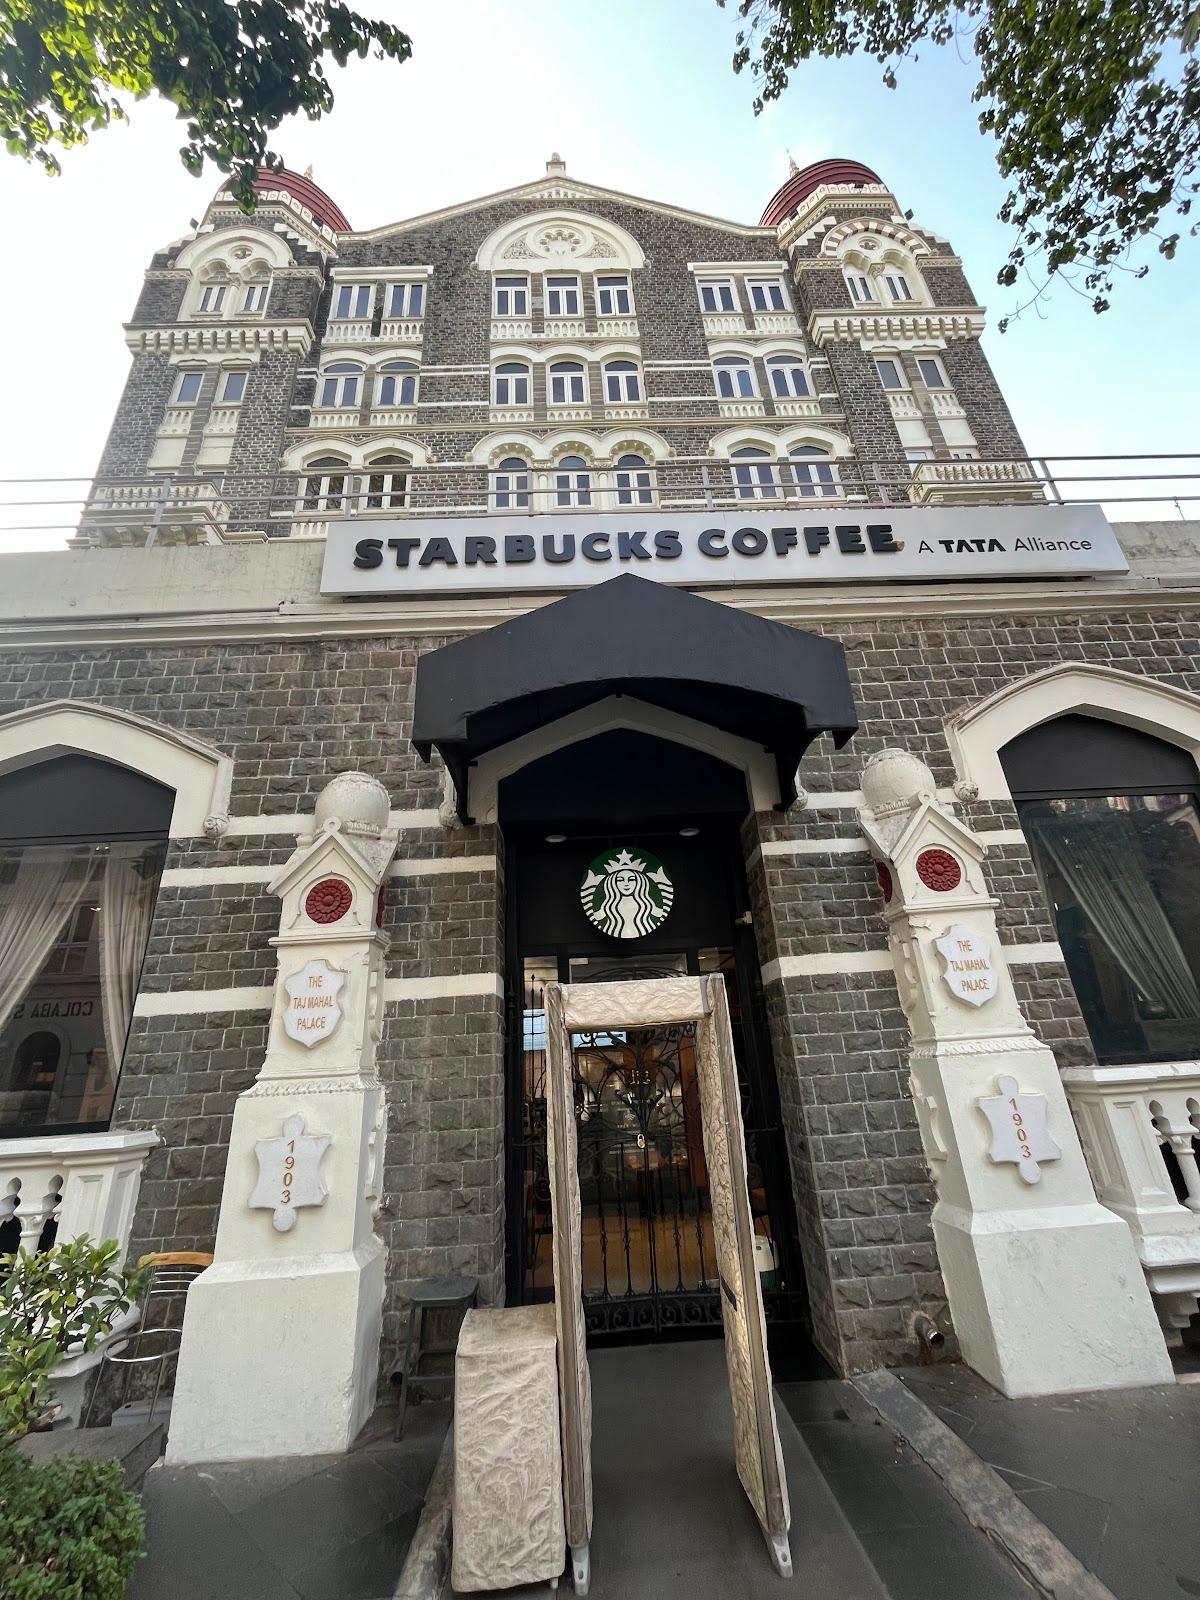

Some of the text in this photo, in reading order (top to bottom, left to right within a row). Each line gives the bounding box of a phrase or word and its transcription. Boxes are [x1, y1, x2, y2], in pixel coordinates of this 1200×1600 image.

[353, 523, 899, 570] STARBUCKS COFFEE
[918, 537, 1093, 554] A TATA Alliance
[957, 940, 973, 952] THE
[950, 958, 990, 973] TAJ MAHAL
[307, 975, 323, 989] THE
[961, 978, 990, 992] PALACE
[293, 995, 334, 1010] TAJ MAHAL
[297, 1016, 327, 1031] PALACE
[1009, 1097, 1032, 1159] 1903
[280, 1139, 295, 1204] 1903
